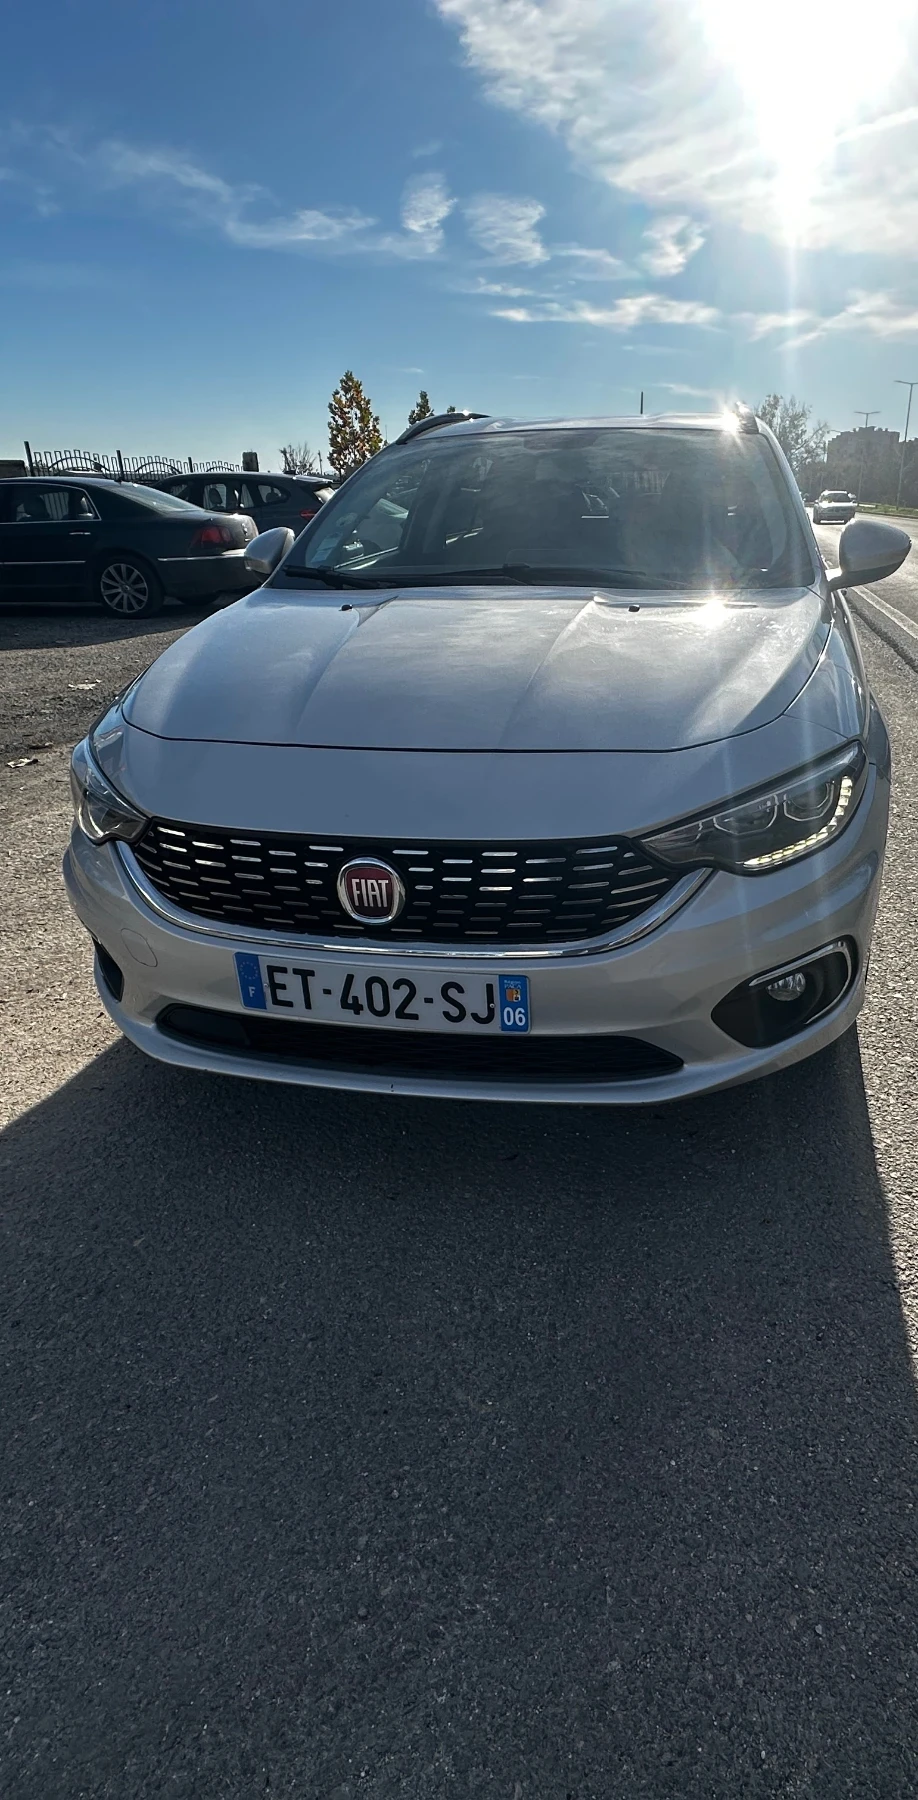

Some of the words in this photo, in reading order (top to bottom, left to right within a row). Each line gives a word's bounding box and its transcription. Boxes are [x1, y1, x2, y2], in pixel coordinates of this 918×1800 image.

[351, 878, 389, 908] FIAT
[248, 986, 256, 998] F
[266, 965, 495, 1024] ET-402-SJ
[503, 1007, 526, 1026] 06
